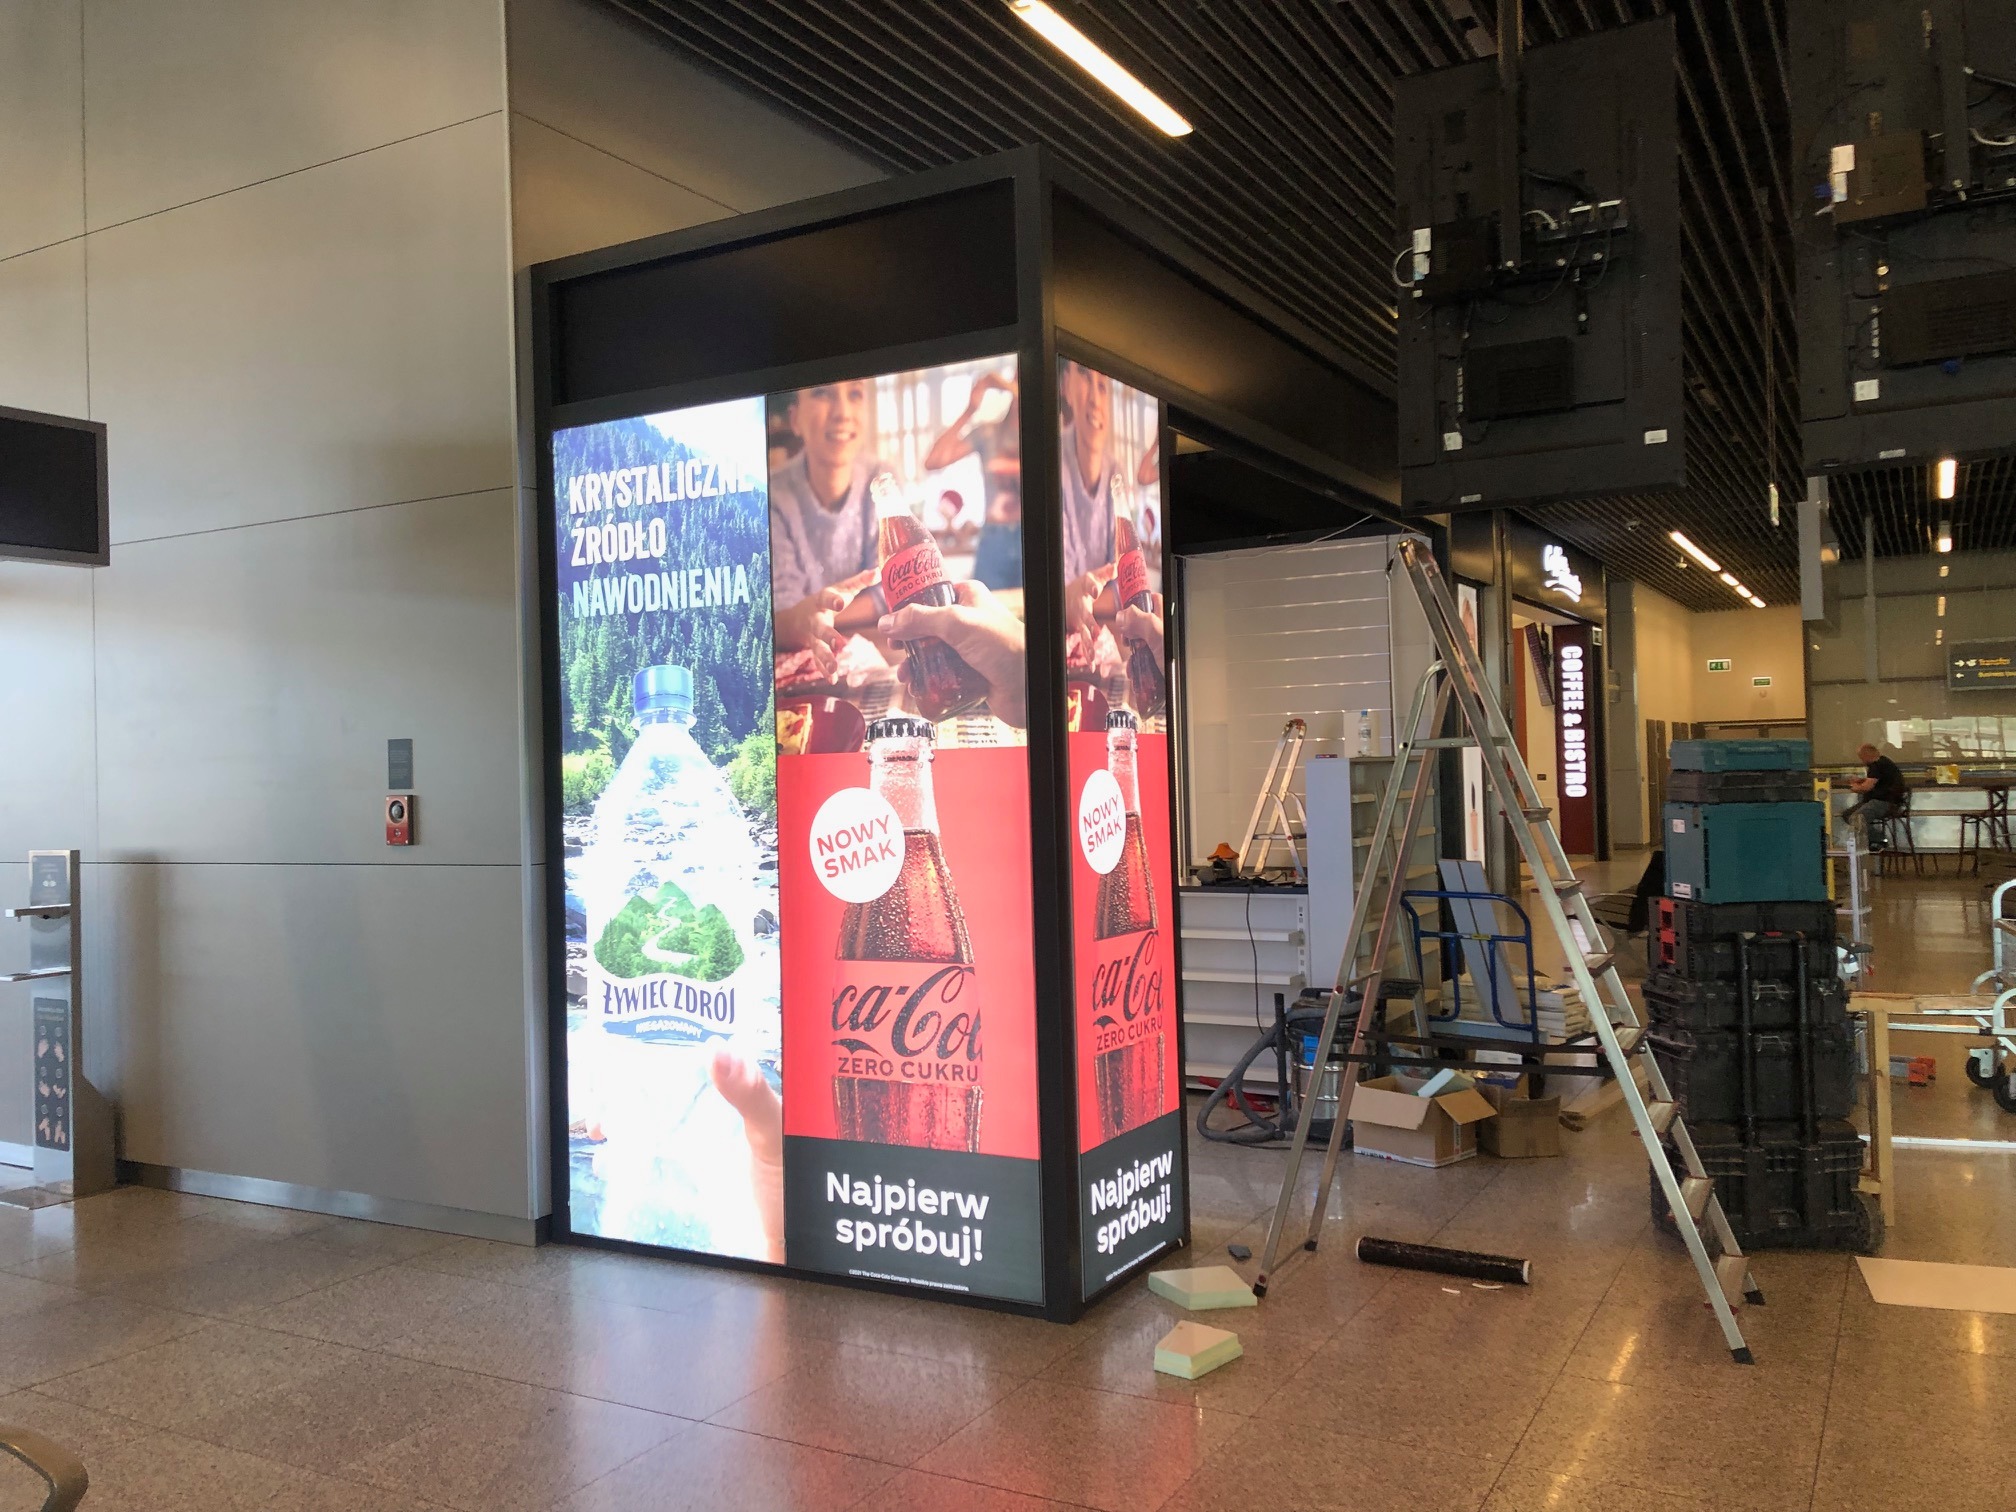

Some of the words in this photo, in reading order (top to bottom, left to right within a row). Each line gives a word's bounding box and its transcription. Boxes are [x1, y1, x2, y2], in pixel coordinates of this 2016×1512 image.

[570, 513, 666, 567] ŹRÓDŁO
[573, 564, 750, 618] NAWODNIENIA
[1561, 646, 1584, 711] COFFEE
[1563, 713, 1582, 727] &
[1564, 729, 1587, 797] BISTRO
[817, 814, 889, 856] NOWY
[1083, 794, 1118, 833] NOWY
[1087, 816, 1122, 853] SMAK
[824, 839, 896, 878] SMAK
[602, 979, 667, 1015] ŻYWIEC
[673, 981, 735, 1024] ZDRÓJ
[1097, 1028, 1125, 1051] ZERO
[1128, 1014, 1162, 1040] CUKRU
[838, 1056, 893, 1077] ZERO
[900, 1060, 978, 1082] CUKRU
[826, 1171, 989, 1220] Najpierw
[1091, 1150, 1173, 1215] Najpierw
[836, 1217, 983, 1267] spróbuj!
[1097, 1183, 1171, 1254] spróbuj!
